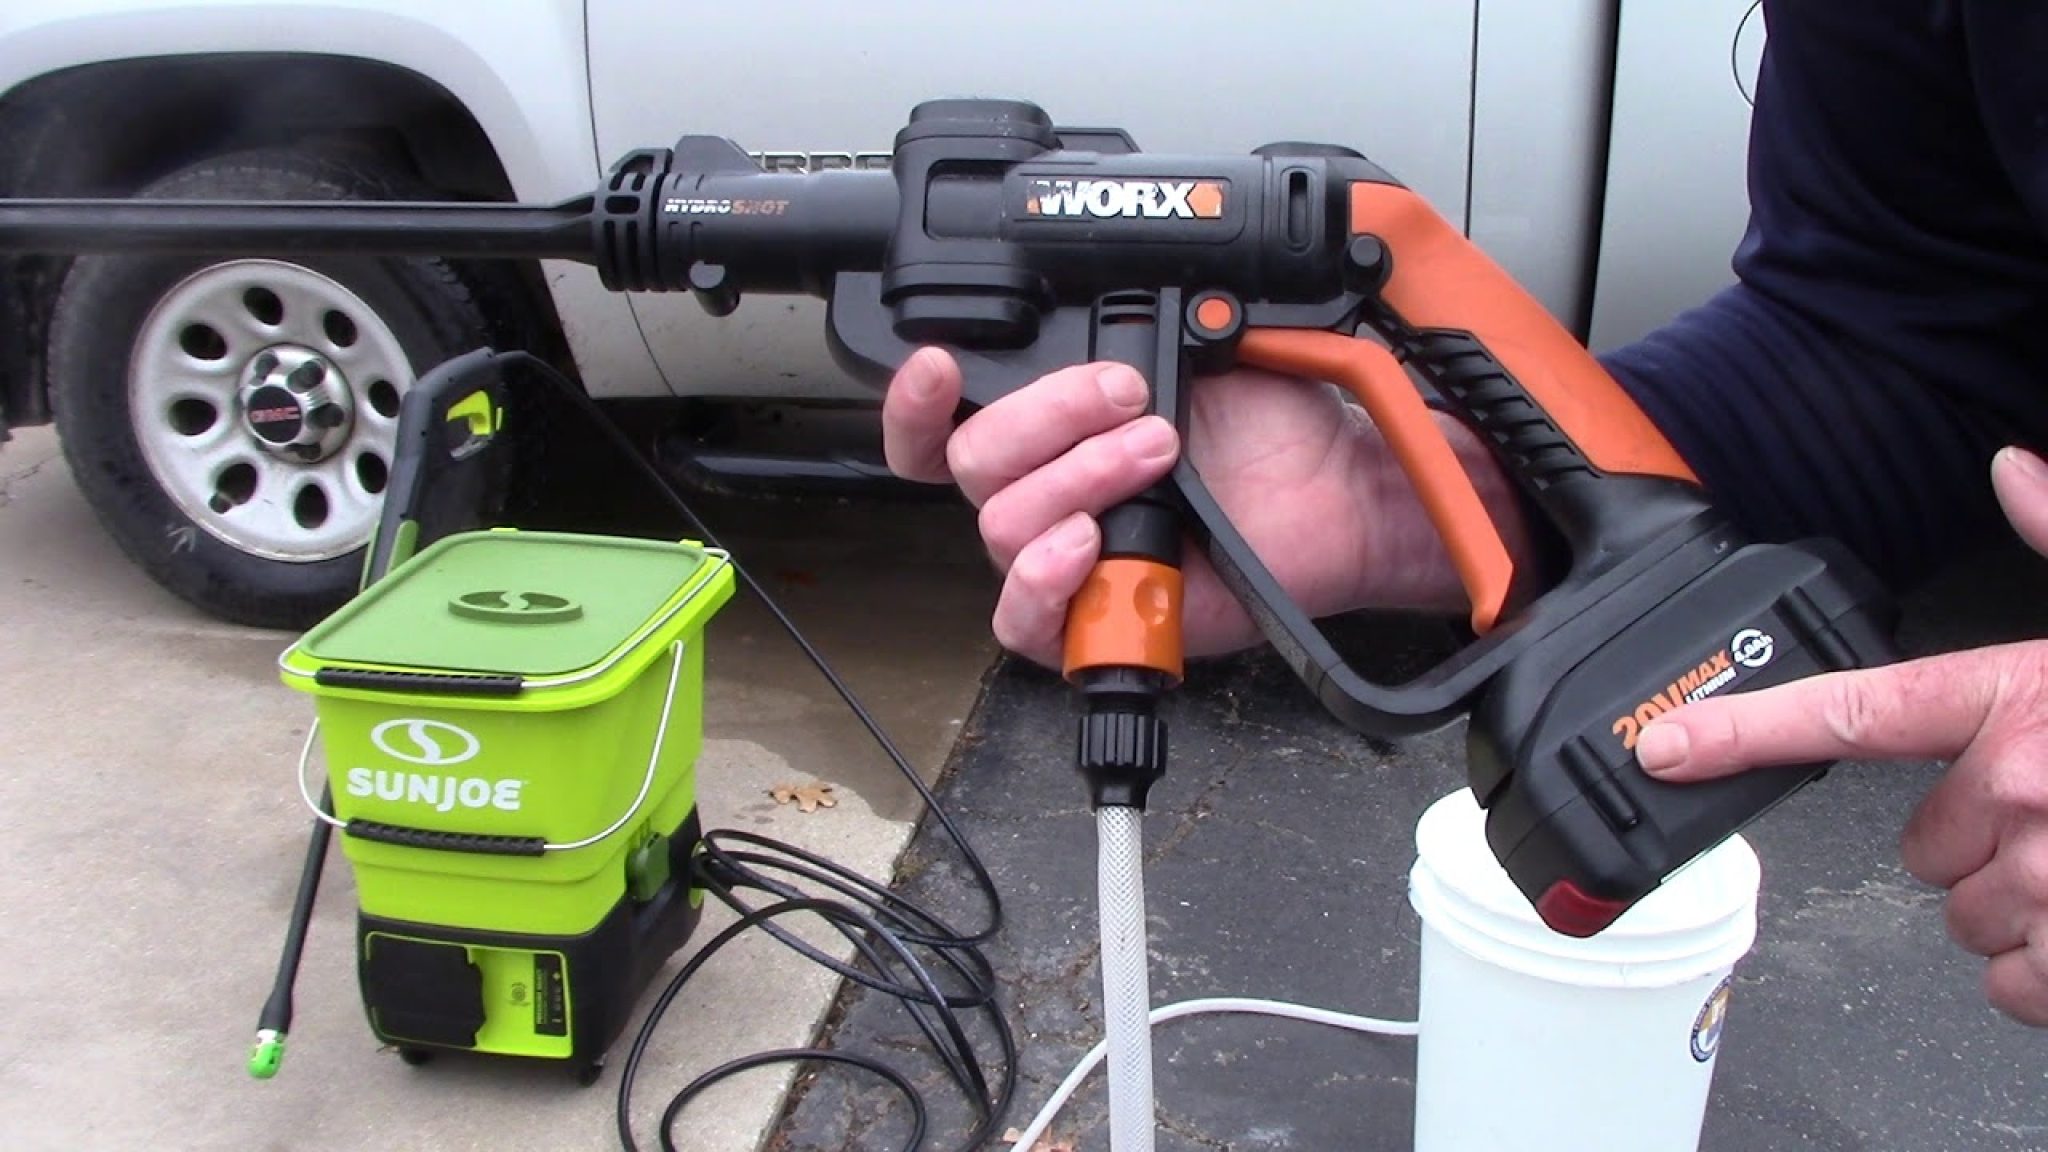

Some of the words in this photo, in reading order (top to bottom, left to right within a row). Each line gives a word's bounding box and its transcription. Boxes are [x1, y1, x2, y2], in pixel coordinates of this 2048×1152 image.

[1035, 180, 1195, 218] WORX
[251, 406, 299, 423] GMC
[1685, 666, 1737, 704] LITHIUM
[346, 767, 522, 812] SUNJOE
